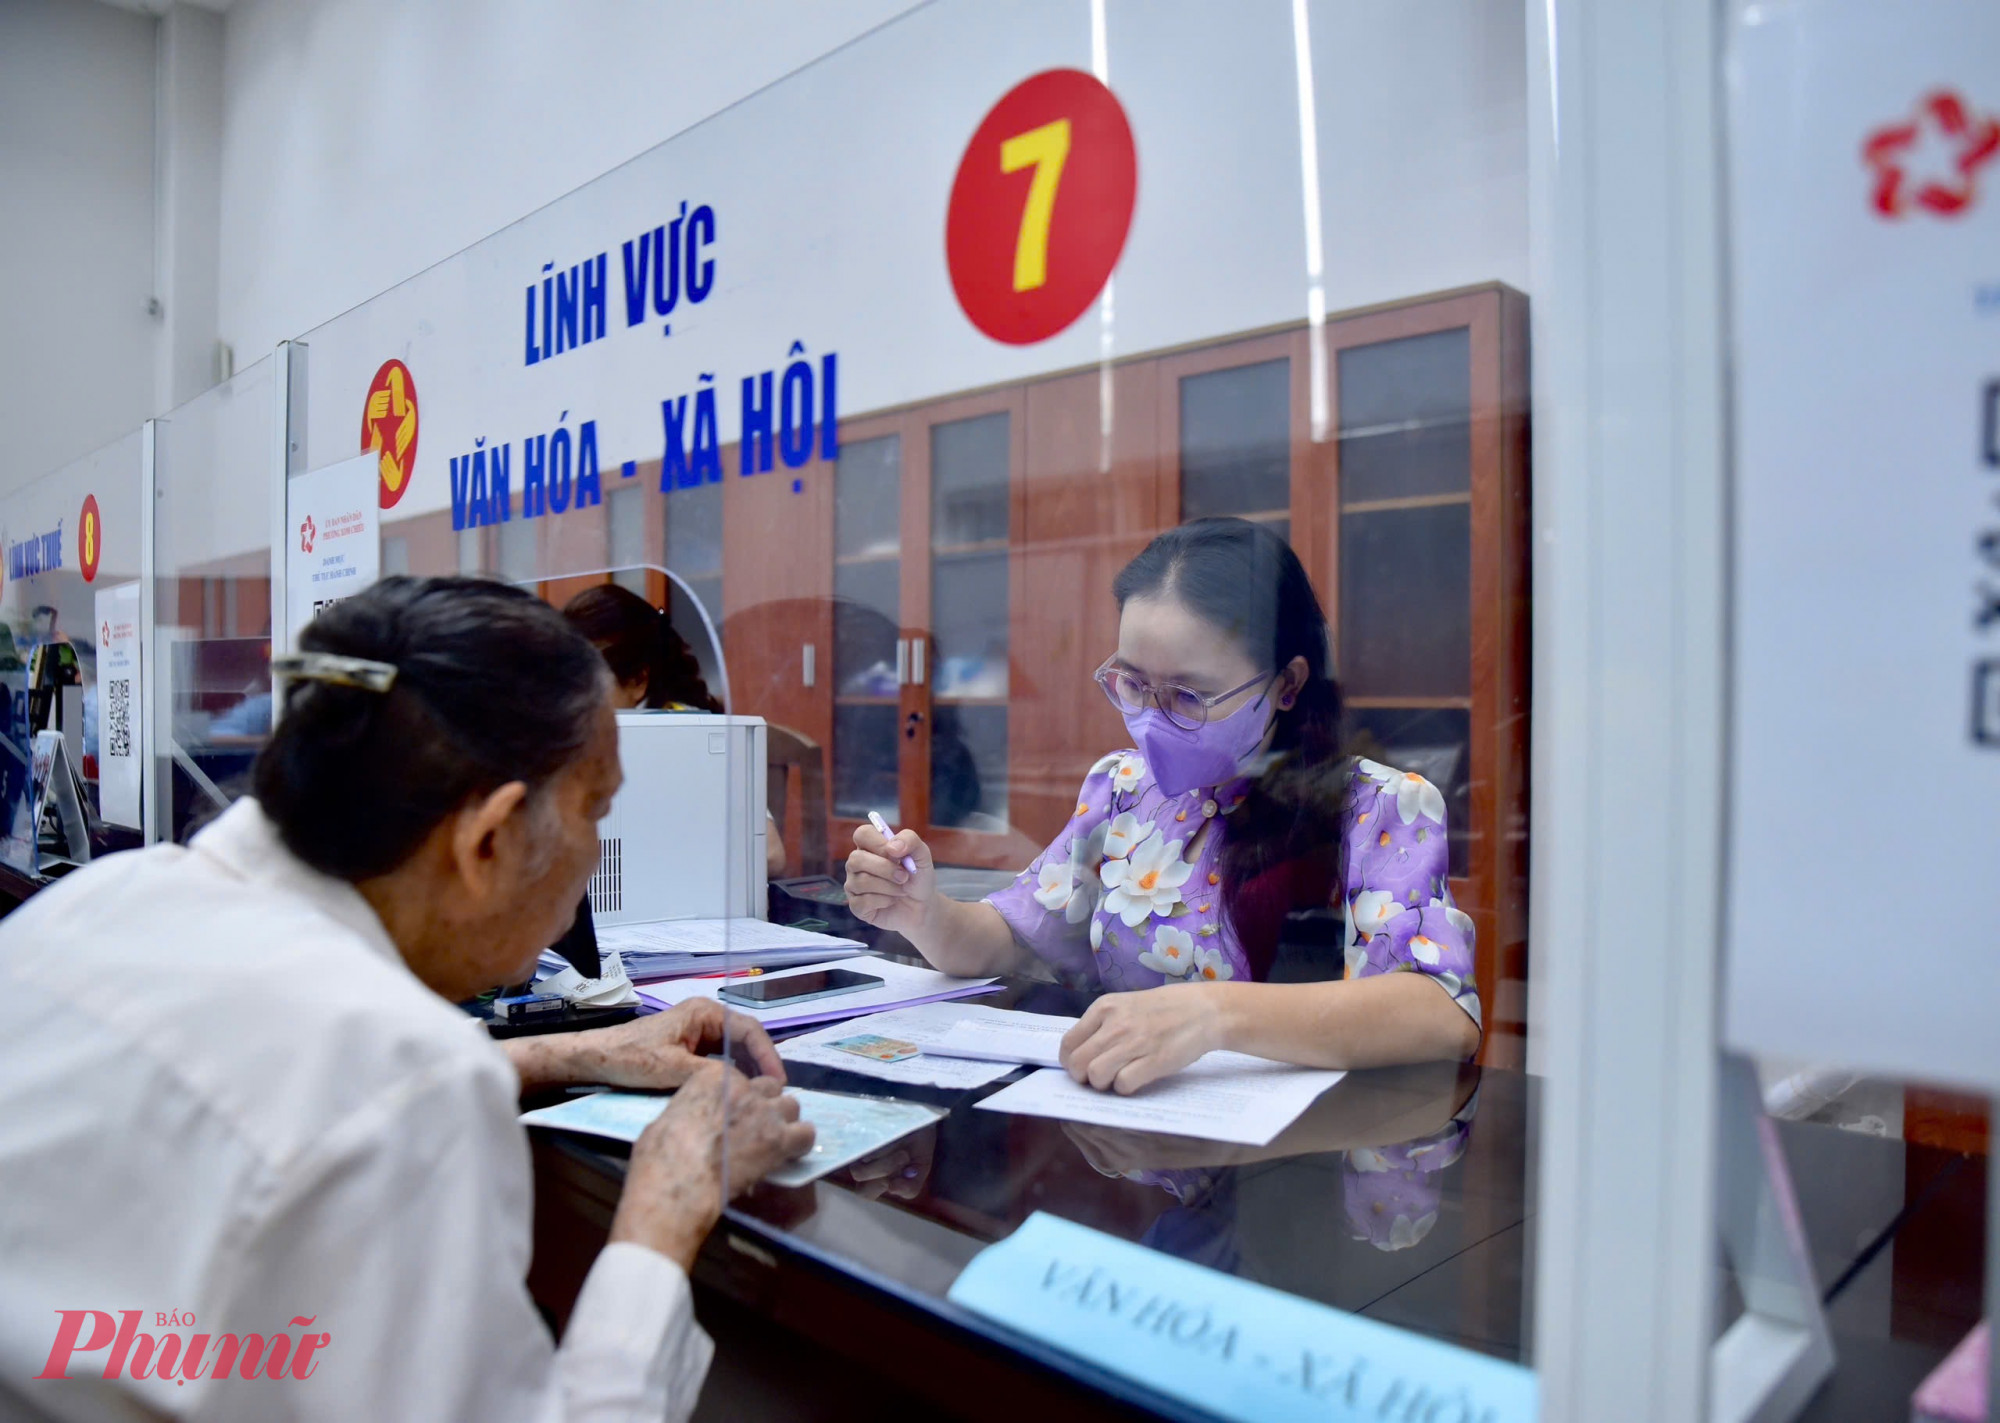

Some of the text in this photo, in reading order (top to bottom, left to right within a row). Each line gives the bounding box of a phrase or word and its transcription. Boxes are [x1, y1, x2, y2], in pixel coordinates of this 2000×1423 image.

[525, 200, 716, 367] LĨNH VỰC
[1000, 116, 1072, 293] 7
[449, 436, 511, 531] VĂN
[522, 410, 601, 519] HÓA
[660, 373, 723, 493] XÃ
[739, 339, 839, 495] HỘI
[24, 532, 40, 585] VỰC
[41, 518, 63, 572] THUẾ
[85, 512, 94, 566] 8
